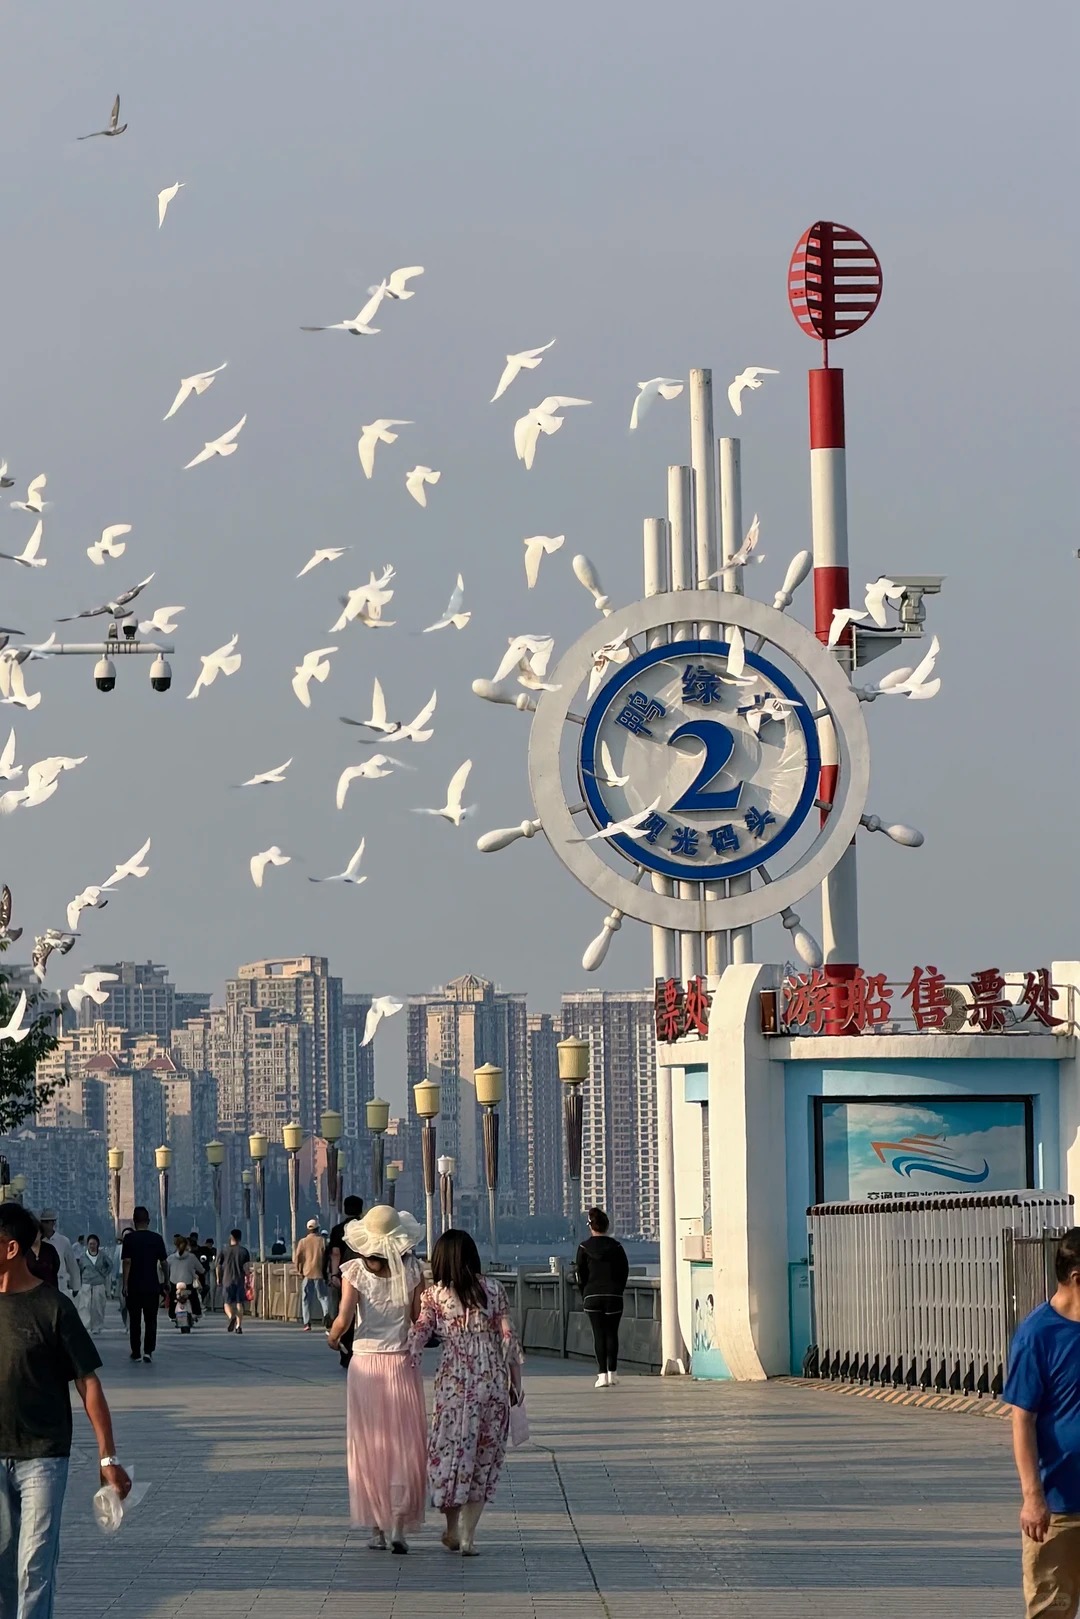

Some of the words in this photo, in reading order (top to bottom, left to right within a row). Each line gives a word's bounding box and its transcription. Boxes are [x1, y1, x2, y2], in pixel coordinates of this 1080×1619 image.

[667, 719, 745, 812] 2
[663, 975, 709, 1041] 票处
[782, 965, 1065, 1035] 游船售票处
